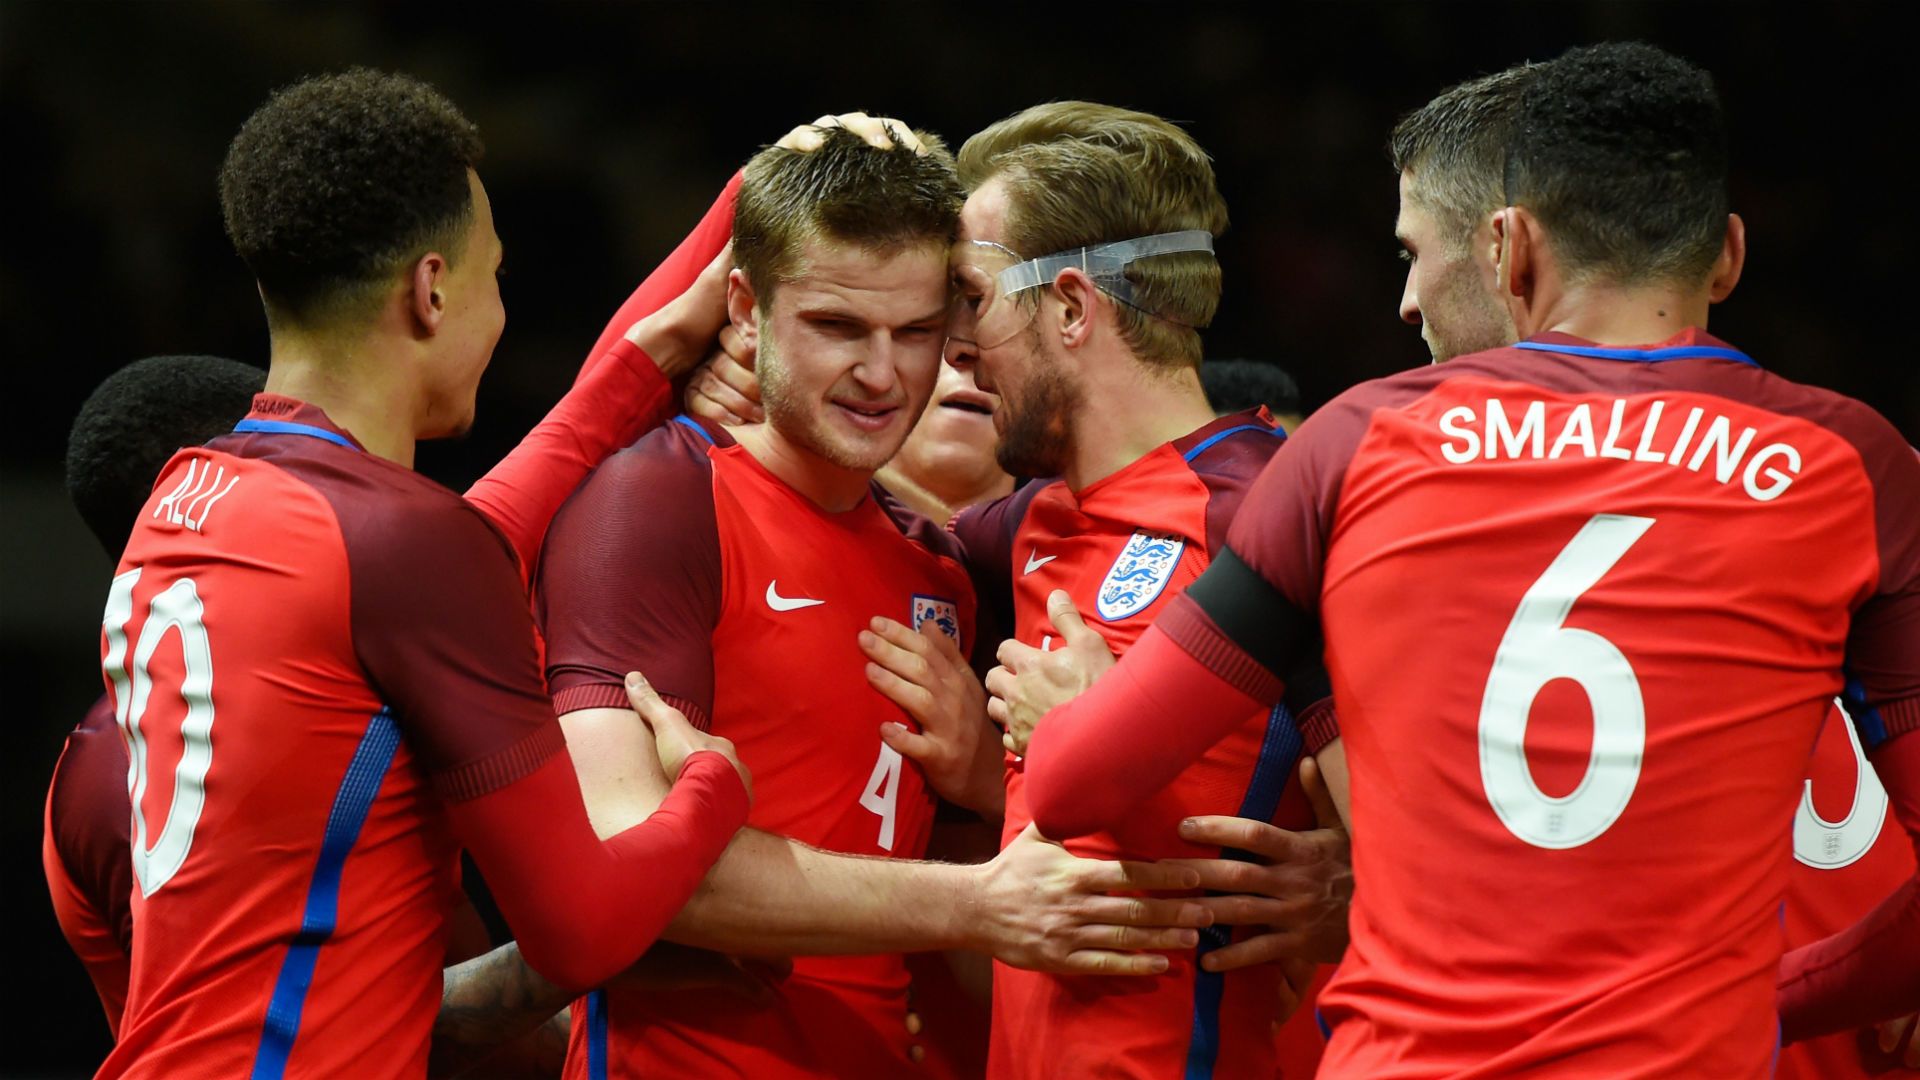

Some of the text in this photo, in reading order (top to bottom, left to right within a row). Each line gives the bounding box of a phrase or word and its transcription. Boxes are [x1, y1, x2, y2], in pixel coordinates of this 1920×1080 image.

[153, 458, 240, 532] ALLI
[1439, 398, 1802, 501] SMALLING
[102, 567, 214, 899] 10
[1478, 513, 1656, 850] 6
[858, 721, 908, 852] 4
